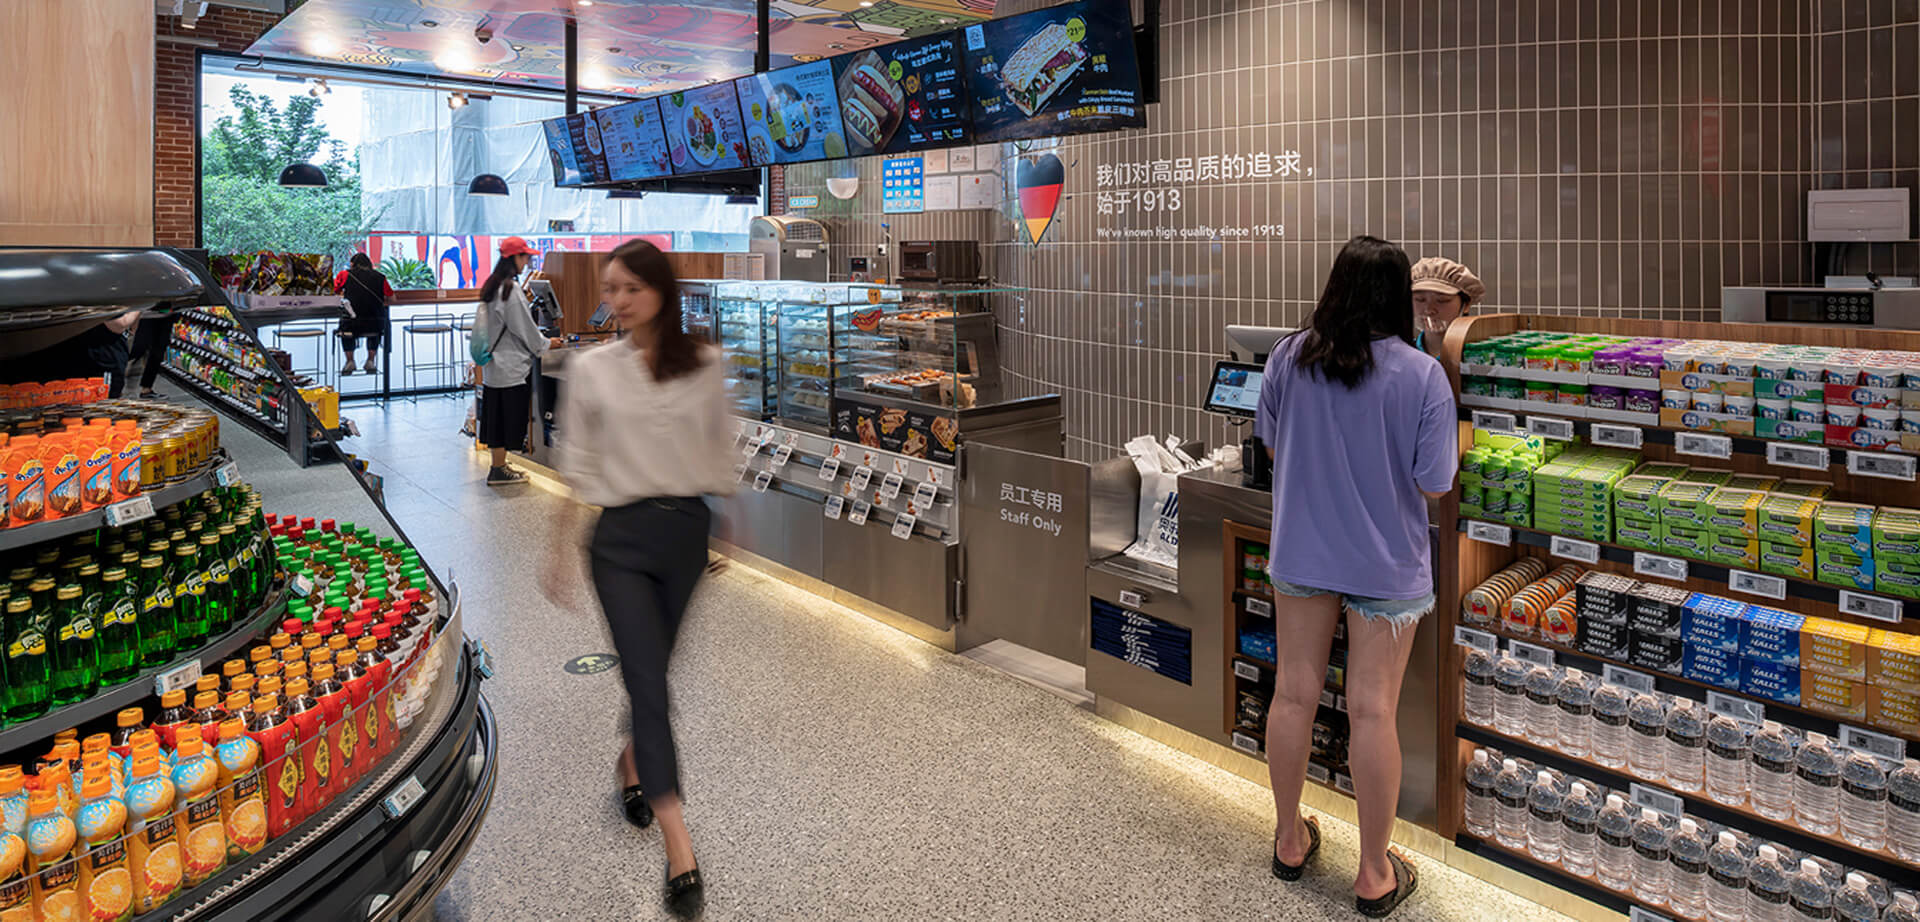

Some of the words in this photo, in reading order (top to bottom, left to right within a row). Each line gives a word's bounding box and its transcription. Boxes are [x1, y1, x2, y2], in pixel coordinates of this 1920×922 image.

[1096, 150, 1314, 187] 我们对高品质的追求，
[1096, 189, 1181, 215] 始于1913
[1097, 227, 1122, 237] We've
[1124, 226, 1153, 237] known
[1155, 225, 1177, 239] high
[1181, 224, 1217, 239] quality
[1220, 225, 1249, 237] since
[1253, 224, 1284, 237] 1913
[1000, 482, 1063, 513] 员工专用
[1000, 508, 1029, 526] Staff
[1032, 515, 1063, 537] Only
[1160, 532, 1179, 546] ALD
